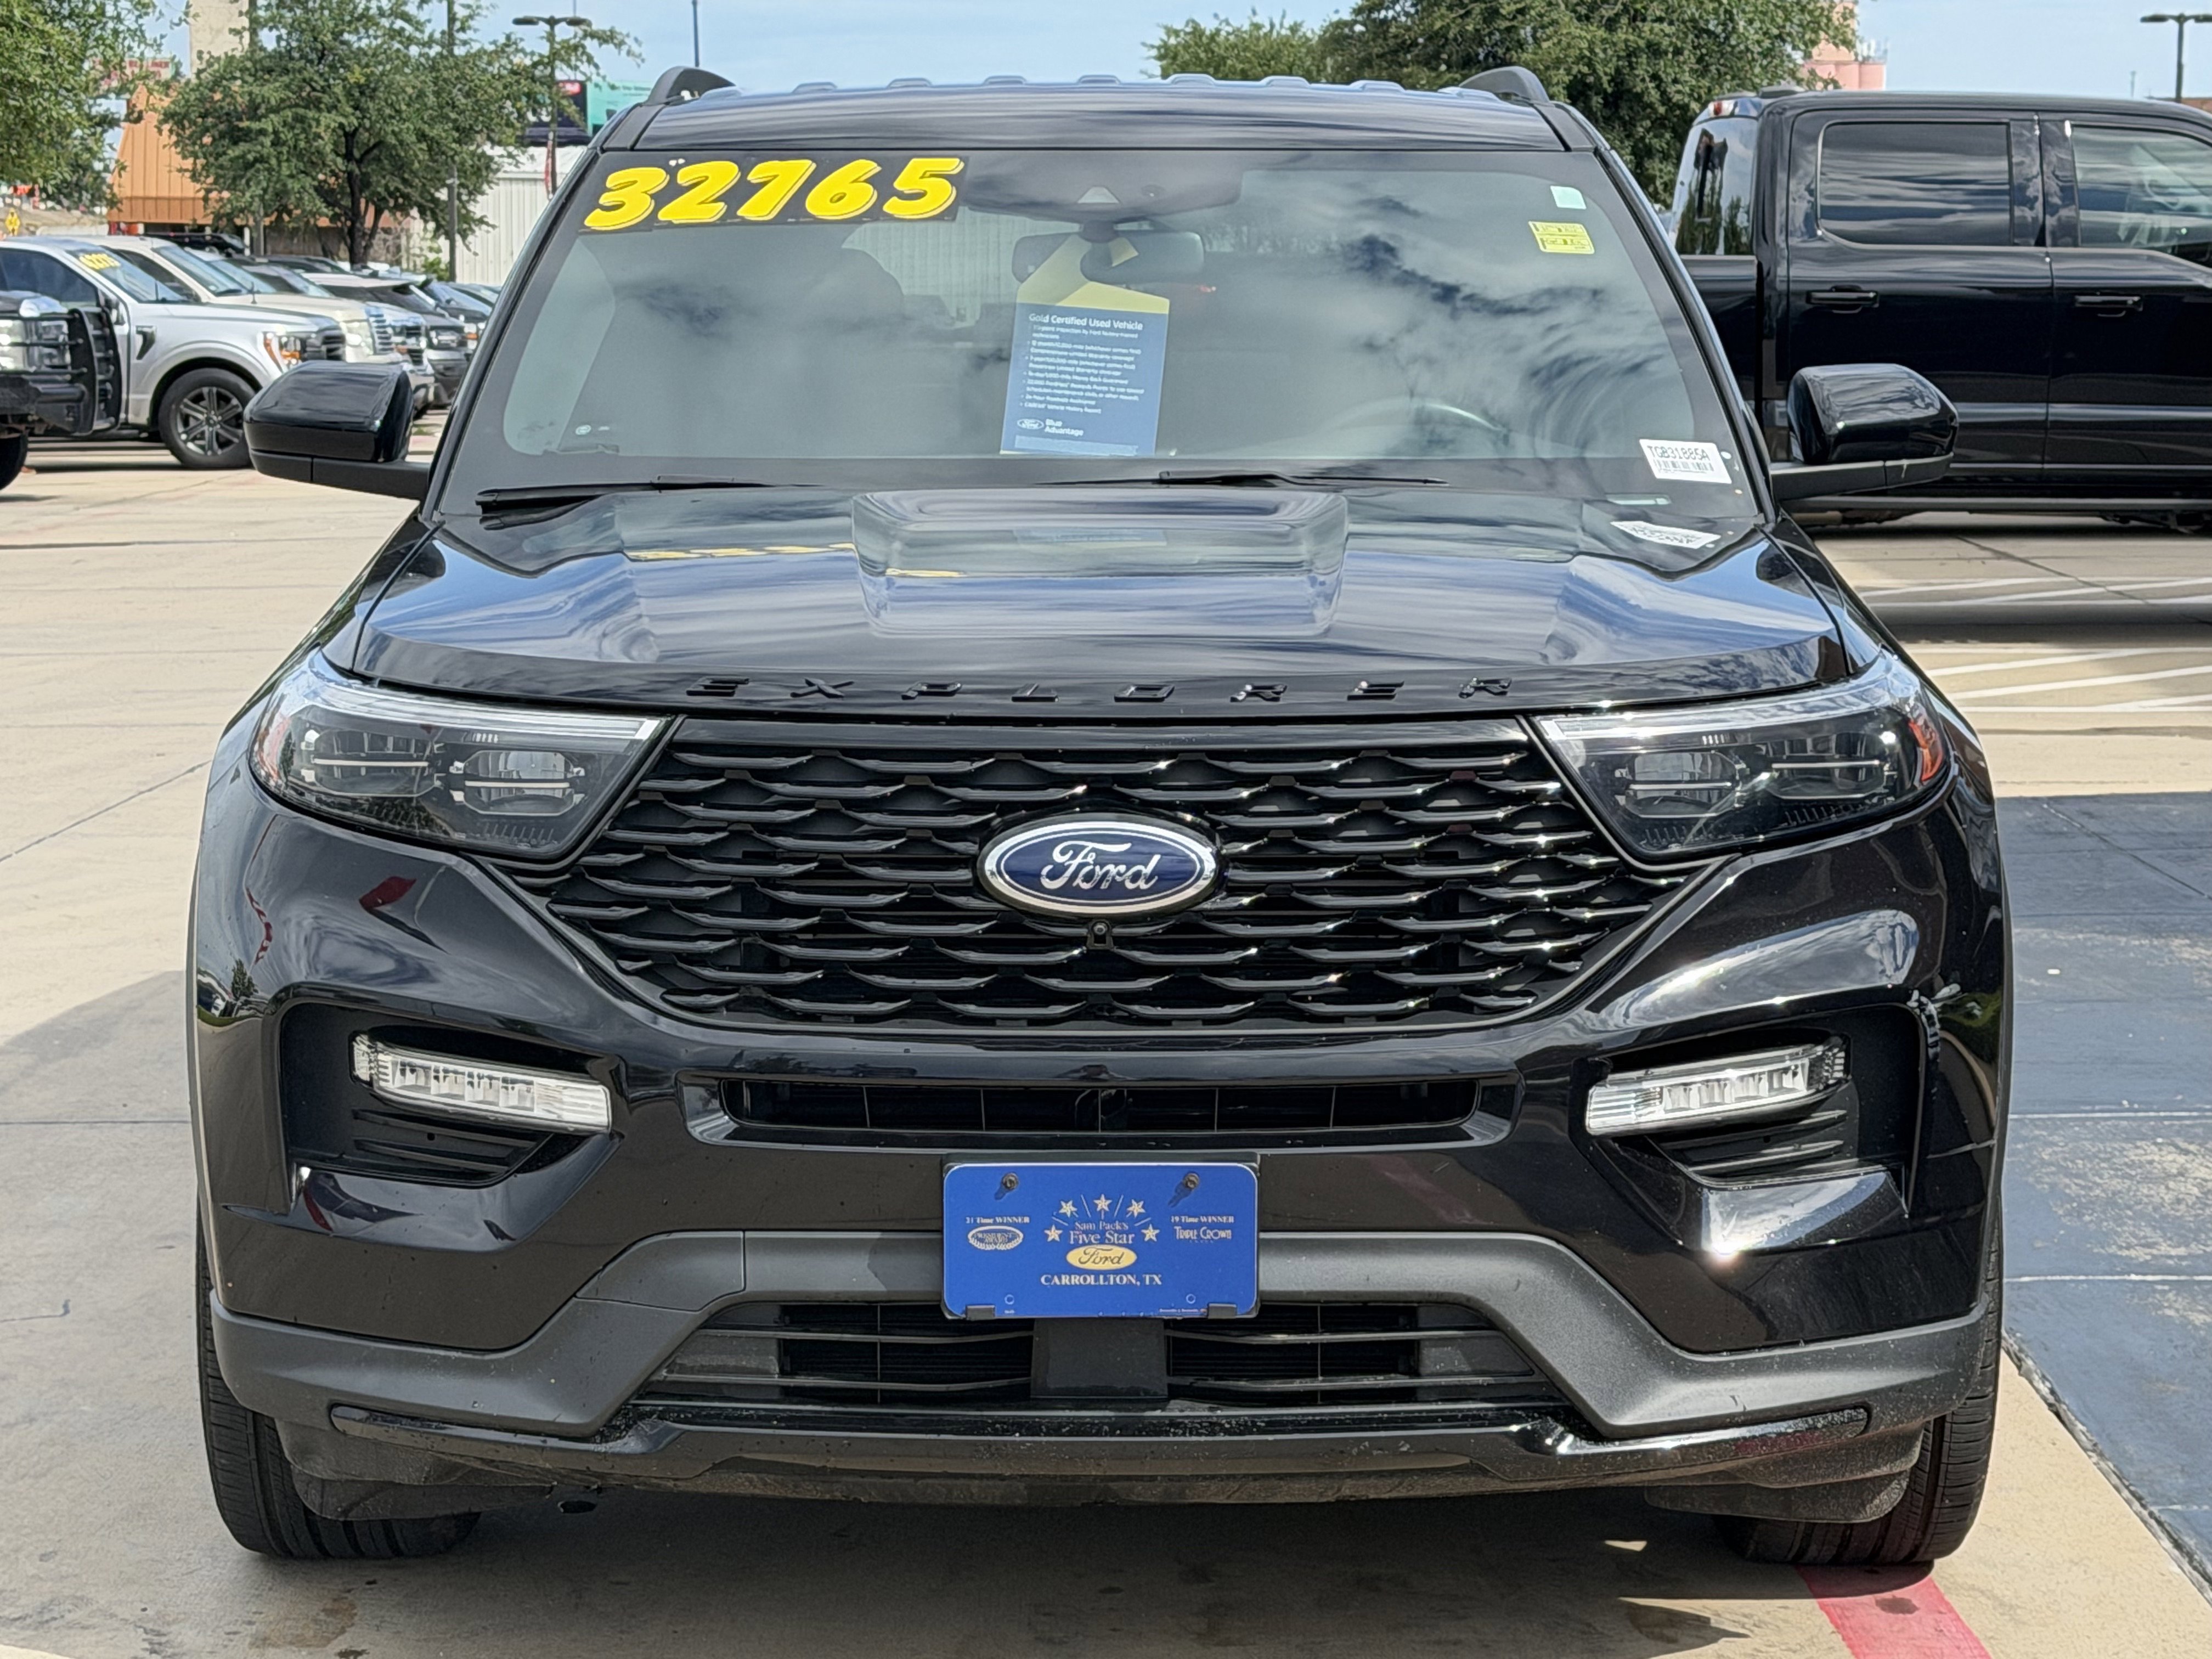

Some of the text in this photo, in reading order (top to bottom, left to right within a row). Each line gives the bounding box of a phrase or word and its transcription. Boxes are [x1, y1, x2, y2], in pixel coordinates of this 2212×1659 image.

[584, 157, 964, 230] 32765
[1029, 313, 1143, 330] Gold Certified Used Vehicle
[1045, 419, 1063, 427] Blue
[1044, 426, 1084, 437] Advantage
[685, 676, 1513, 703] EXPLORER
[1040, 840, 1161, 890] Ford
[1075, 1220, 1129, 1231] Sam Pack's
[1200, 1215, 1234, 1223] WINNER
[1069, 1230, 1135, 1245] Five Star
[1078, 1246, 1125, 1266] Ford
[1040, 1274, 1163, 1286] CARROLLTON, TX
